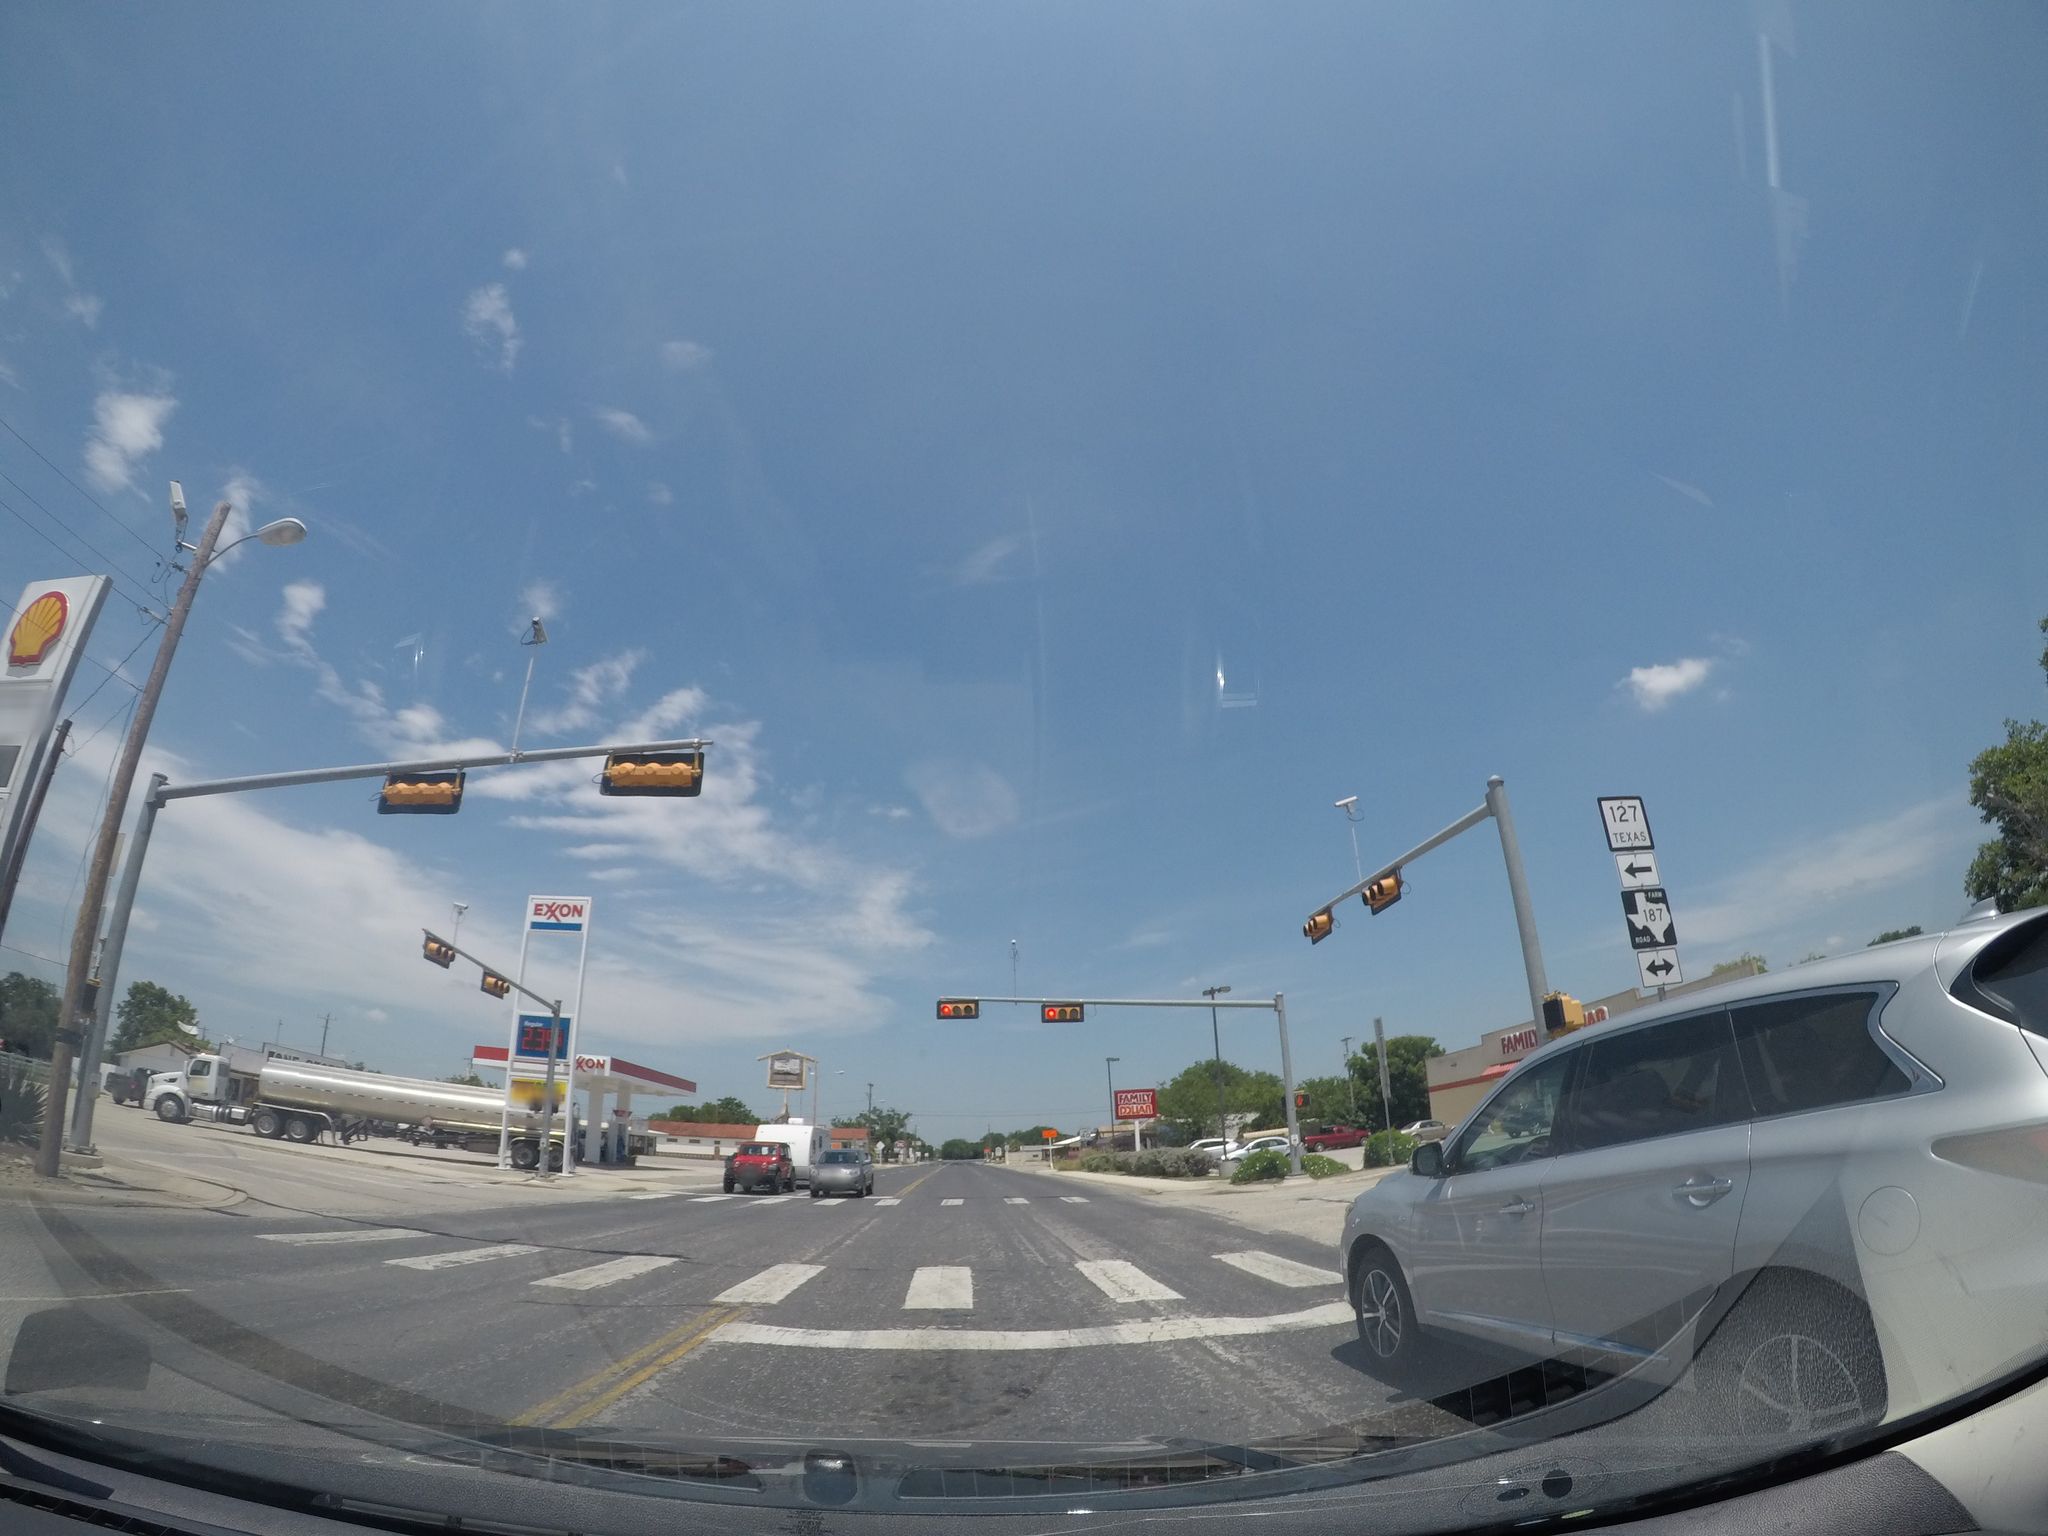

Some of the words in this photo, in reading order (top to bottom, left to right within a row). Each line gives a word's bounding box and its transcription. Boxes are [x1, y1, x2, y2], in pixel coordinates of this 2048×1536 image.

[1609, 805, 1637, 823] 127
[1613, 831, 1647, 843] TEXAS
[533, 902, 583, 922] EXXON
[1643, 908, 1663, 922] 187
[1635, 936, 1651, 944] ROAD
[1119, 1093, 1152, 1104] FAMILY
